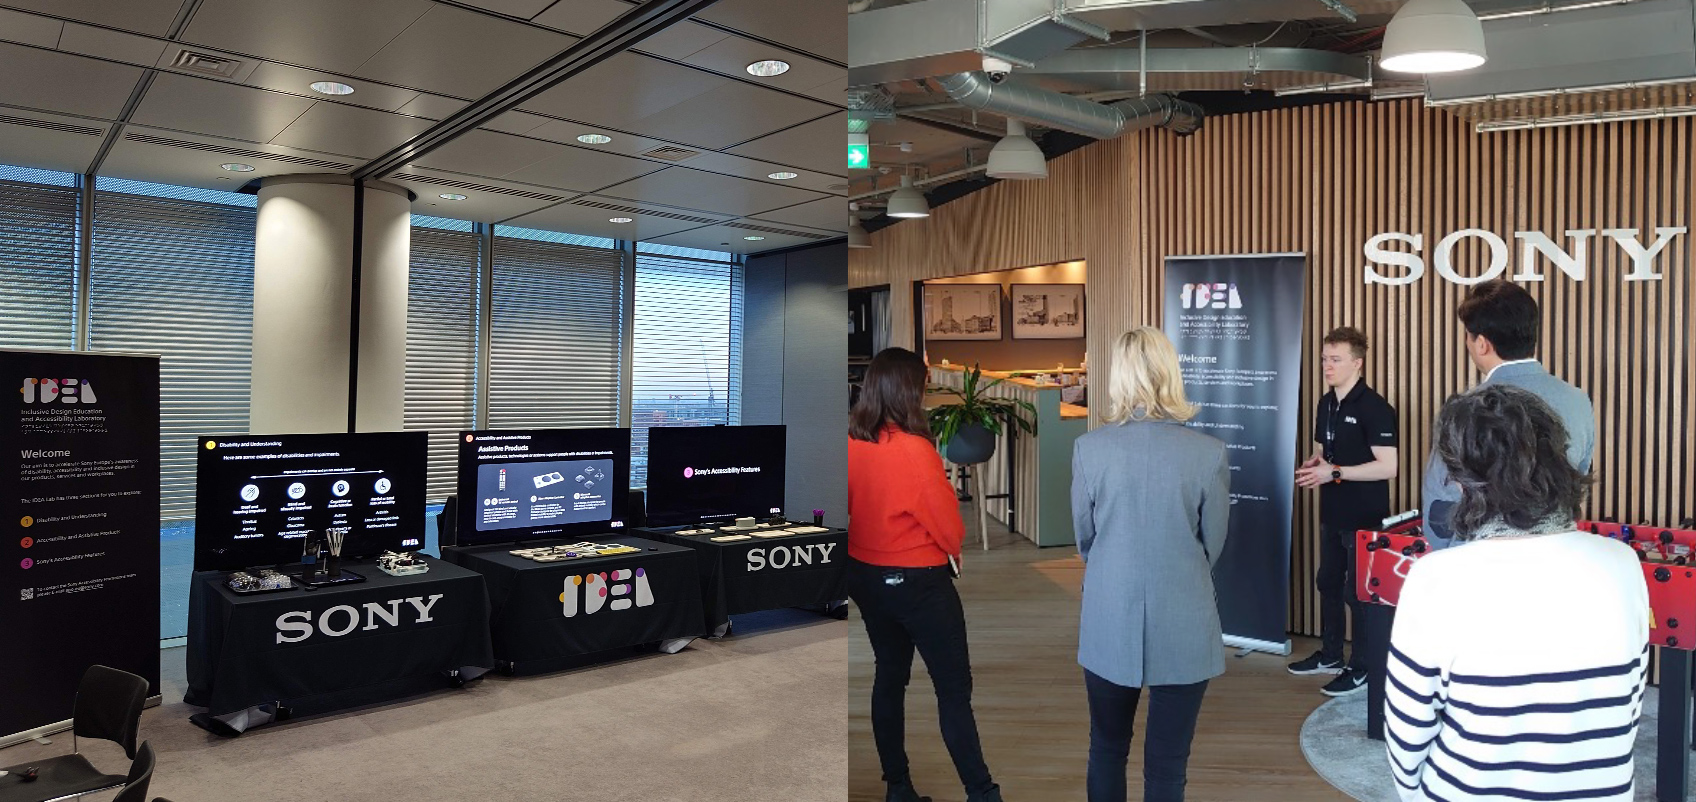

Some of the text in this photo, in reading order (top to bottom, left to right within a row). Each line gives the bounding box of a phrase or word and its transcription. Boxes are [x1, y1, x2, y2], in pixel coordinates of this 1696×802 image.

[1364, 226, 1687, 286] SONY
[1180, 283, 1243, 309] IDEA
[1178, 354, 1217, 363] Welcome
[20, 378, 97, 403] IDEA
[35, 415, 73, 423] Accessibility
[74, 415, 106, 423] Laboratory
[51, 408, 72, 416] Design
[21, 449, 71, 459] Welcome
[478, 444, 529, 453] Assistive Products
[694, 468, 710, 476] Sony's
[710, 466, 740, 475] Accessibility
[747, 542, 837, 572] SONY
[559, 567, 655, 618] IDEA
[275, 593, 444, 644] SONY
